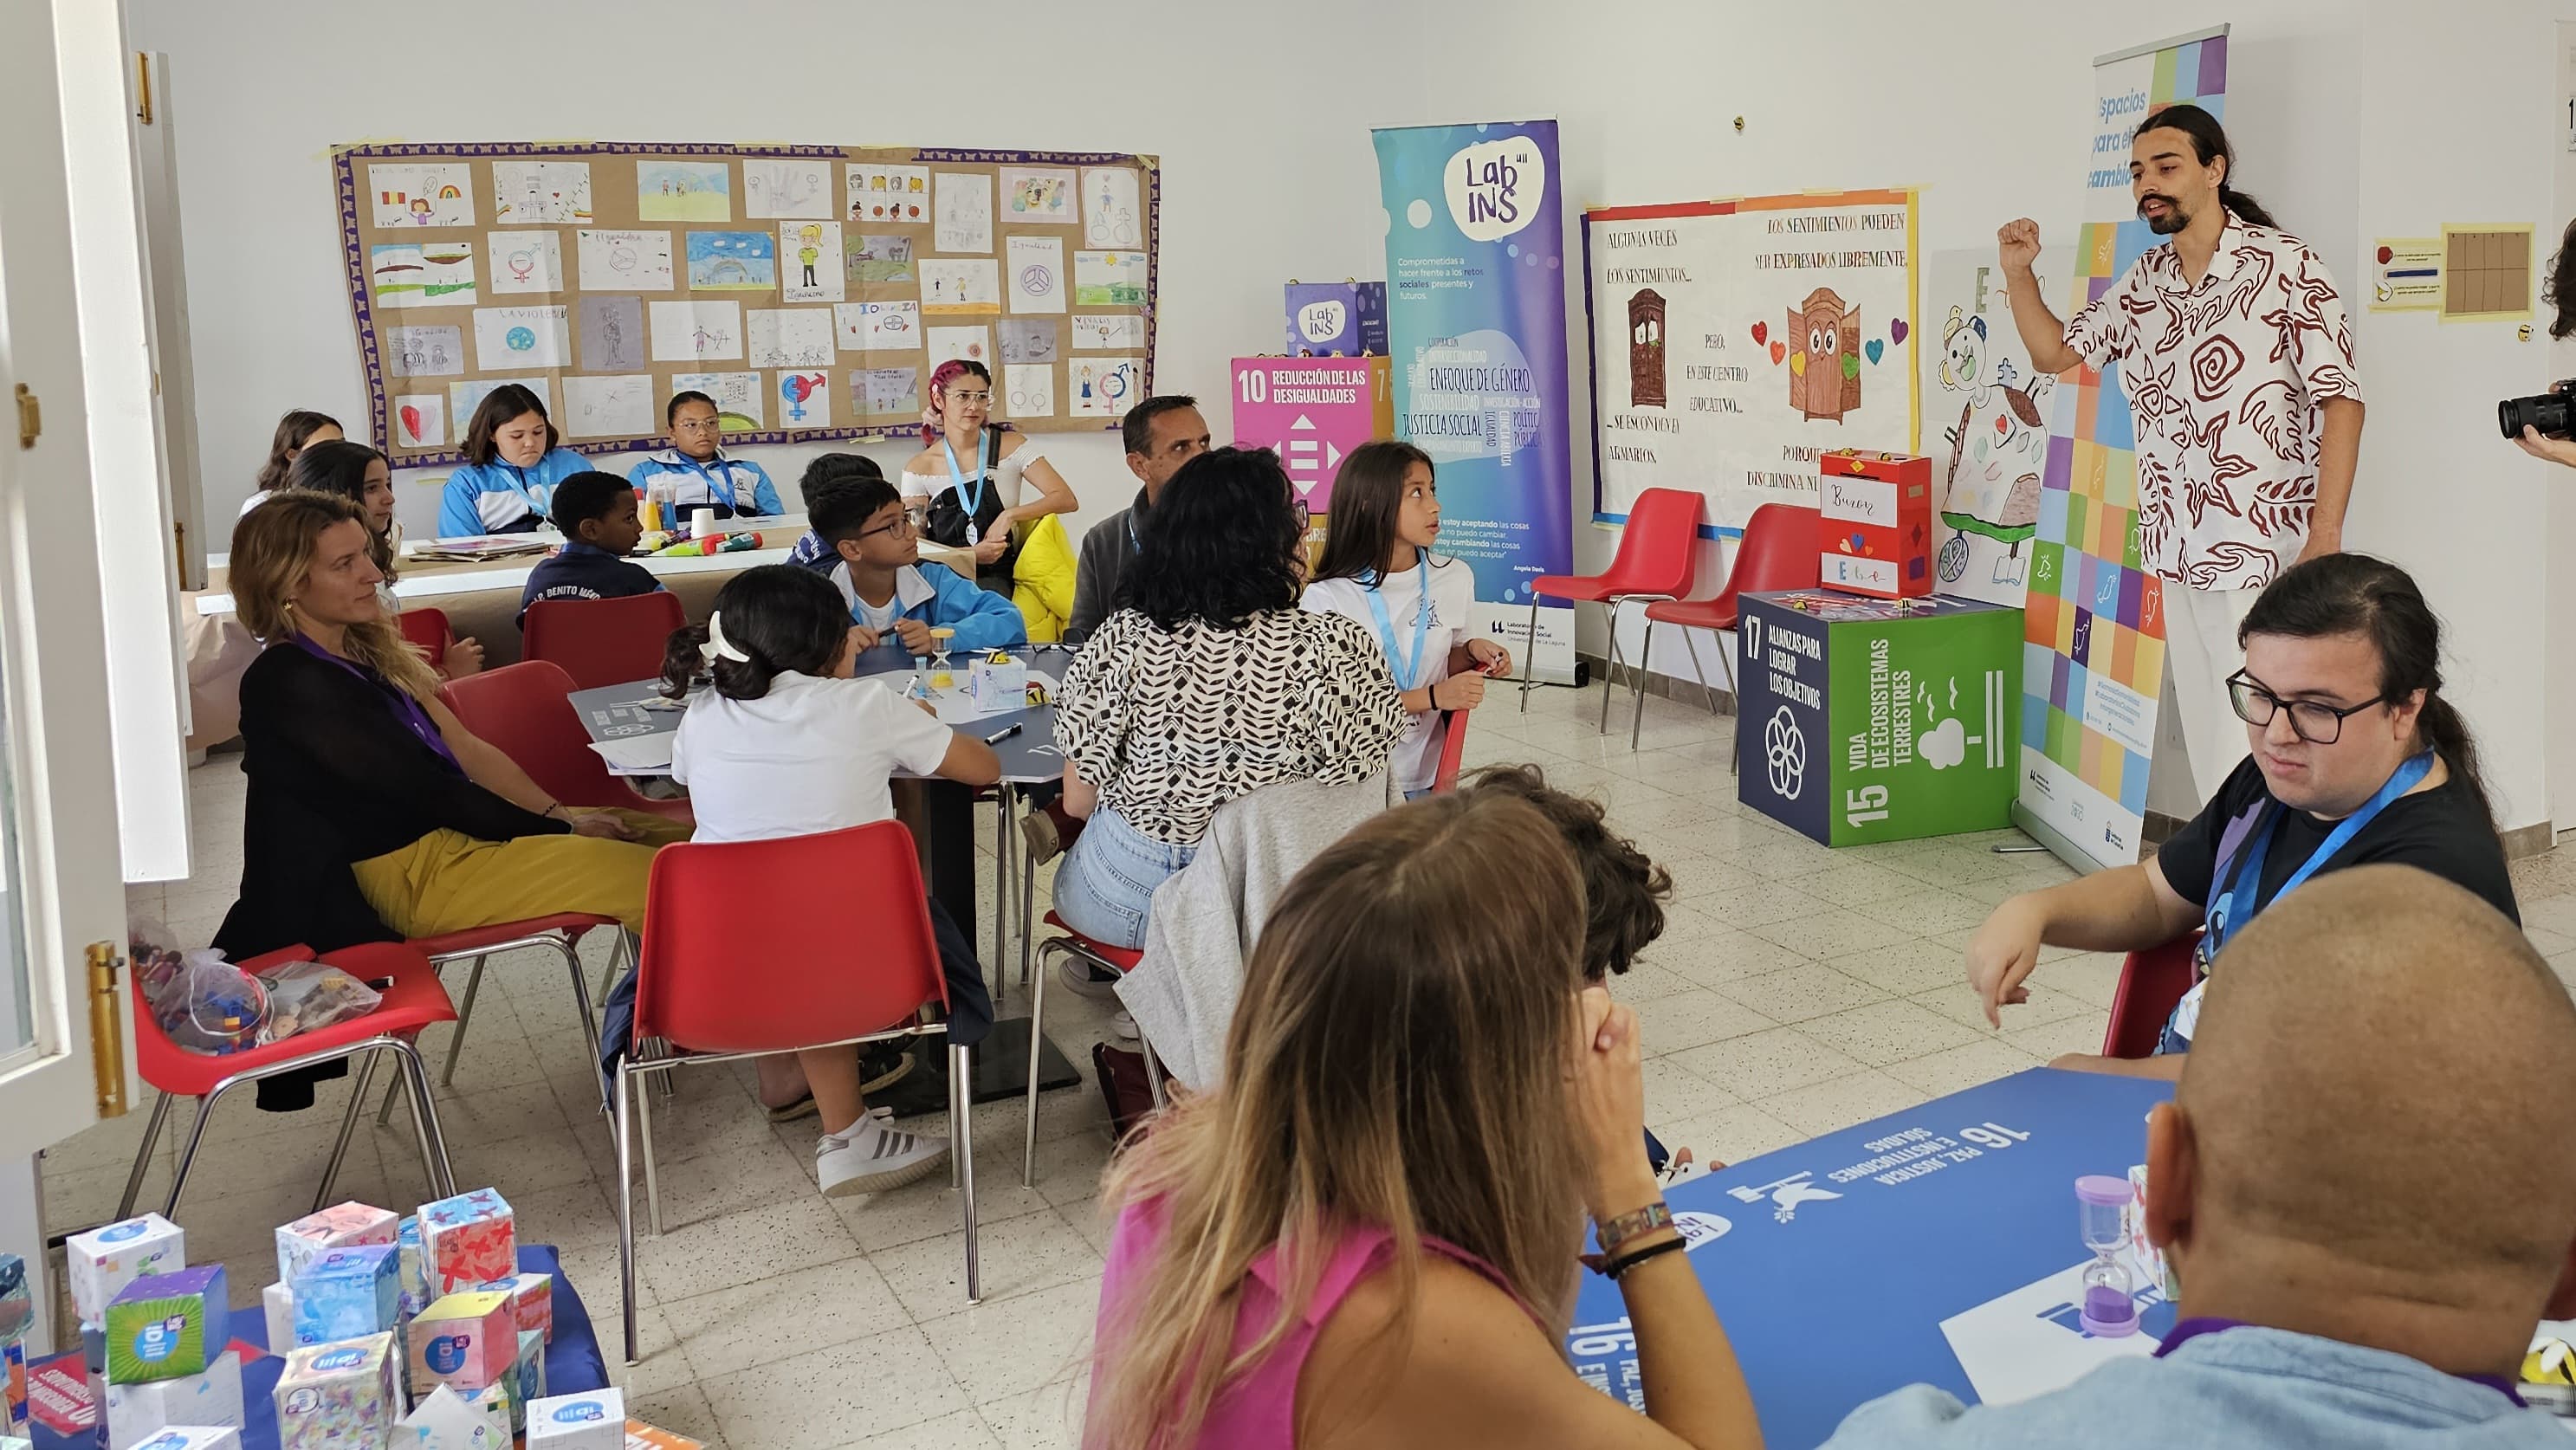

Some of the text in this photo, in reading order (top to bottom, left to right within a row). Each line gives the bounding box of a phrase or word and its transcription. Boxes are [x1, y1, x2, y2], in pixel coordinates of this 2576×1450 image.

[1466, 154, 1518, 189] Lab
[1468, 187, 1518, 223] INS
[1861, 213, 1905, 230] PUEDEN
[1648, 230, 1677, 248] VECES
[1397, 256, 1459, 267] Comprometidas
[1773, 251, 1836, 269] EXPRESADOS
[1420, 268, 1444, 277] frente
[1451, 268, 1463, 276] los
[1464, 268, 1484, 276] retos
[1607, 268, 1624, 284] LOS
[1399, 279, 1429, 288] sociales
[1431, 280, 1467, 290] presentes
[1309, 307, 1333, 321] Lab
[1310, 320, 1334, 336] INS
[1272, 368, 1366, 386] REDUCCIÓN DE LAS
[1430, 367, 1475, 394] ENFOQUE
[1476, 367, 1489, 392] DE
[1492, 362, 1531, 392] GÉNERO
[1713, 366, 1749, 382] CENTRO
[1238, 369, 1266, 404] 10
[1377, 369, 1385, 402] 7
[1273, 389, 1356, 404] DESIGUALDADES
[1420, 393, 1479, 411] SOSTENIBILIDAD
[1402, 413, 1482, 437] JUSTICIA SOCIAL
[1513, 409, 1544, 428] POLÍTIC
[1485, 411, 1497, 447] IGUALDAD
[1746, 470, 1804, 490] DISCRIMINA
[1442, 519, 1460, 528] estoy
[1460, 519, 1498, 529] aceptando
[1498, 521, 1509, 529] las
[1456, 528, 1478, 539] puedo
[1451, 538, 1490, 548] cambiando
[1501, 541, 1520, 550] cosas
[1457, 548, 1479, 558] puedo
[1513, 565, 1531, 573] Angela
[547, 586, 578, 598] BENITO
[1744, 614, 1762, 660] 17
[1768, 624, 1822, 662] ALIANZAS PARA
[1769, 648, 1796, 676] LOGRAR
[1769, 671, 1821, 710] LOS OBJETIVOS
[1870, 638, 1890, 769] DE ECOSISTEMAS
[1893, 670, 1912, 767] TERRESTRES
[1848, 732, 1867, 772] VIDA
[1847, 784, 1889, 828] 15
[1863, 1127, 1933, 1154] SÓLIDAS
[1959, 1122, 2031, 1149] 16
[1827, 1136, 1958, 1183] E INSTITUCIONES
[1873, 1146, 1984, 1186] PAZ, JUSTICIA
